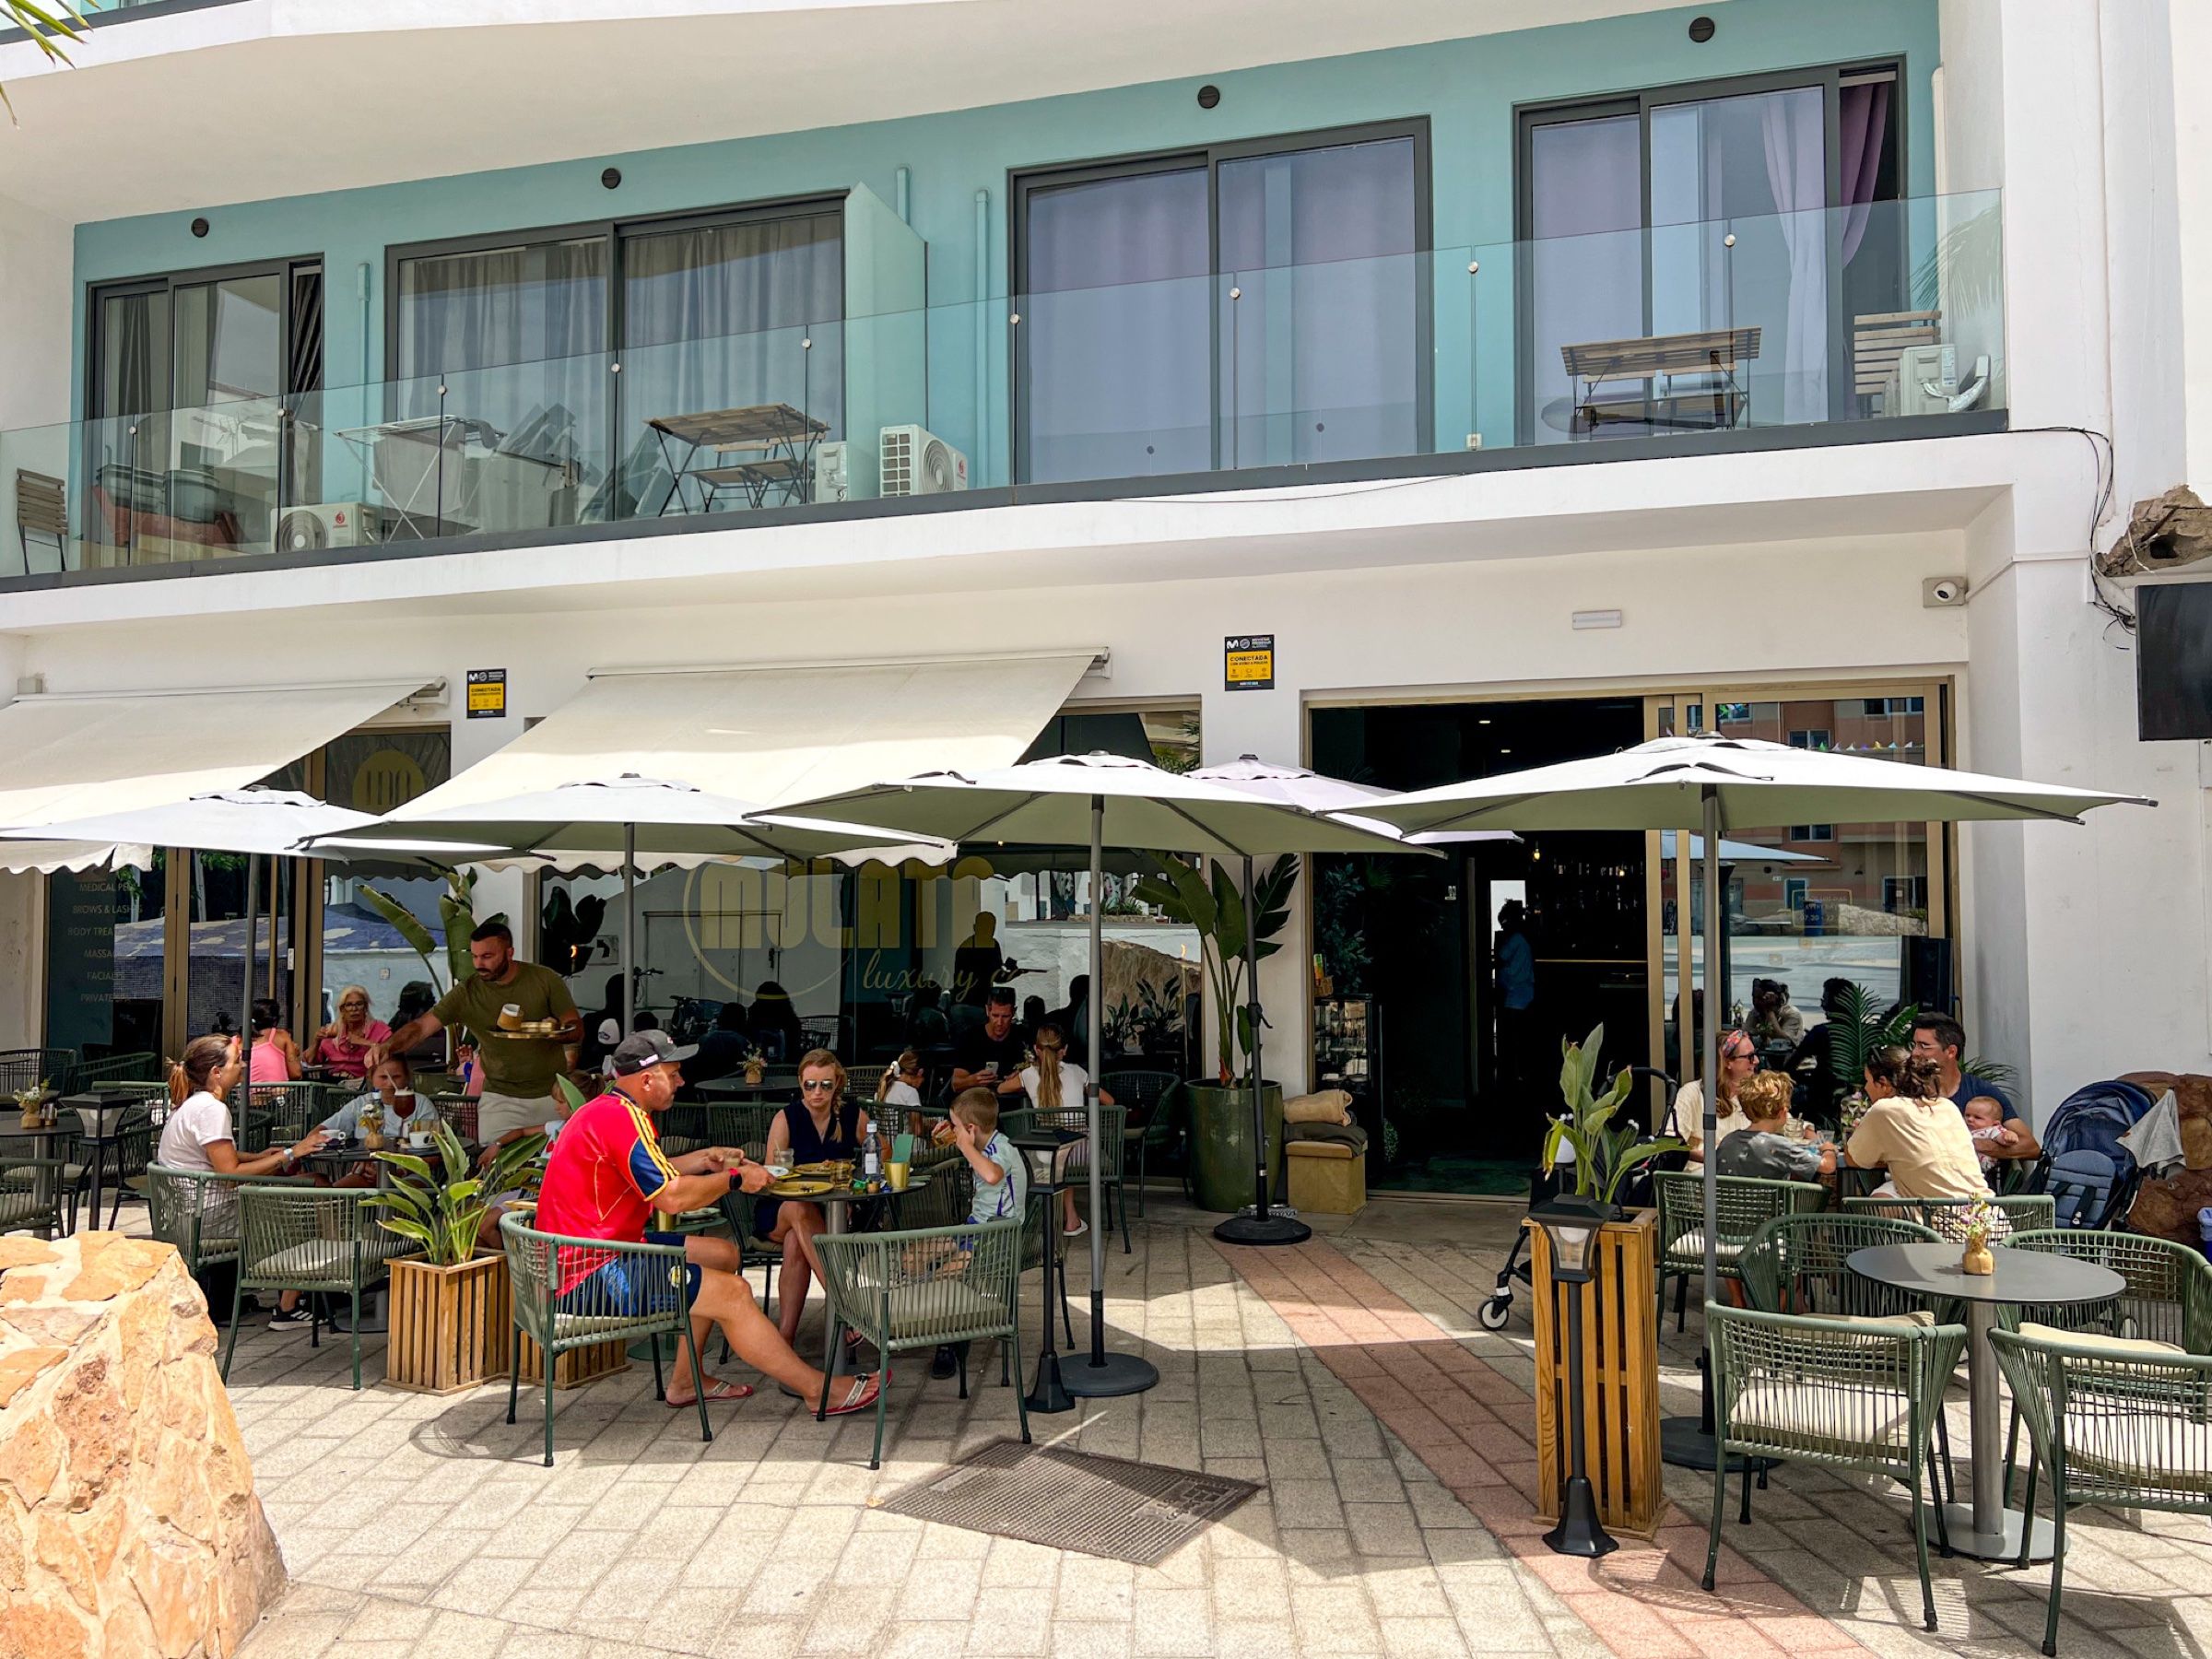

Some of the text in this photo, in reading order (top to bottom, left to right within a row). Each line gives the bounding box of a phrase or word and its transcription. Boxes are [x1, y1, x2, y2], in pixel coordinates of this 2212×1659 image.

[79, 883, 115, 893] MEDICAL
[73, 905, 103, 914] BROWS
[104, 905, 111, 914] &
[67, 927, 91, 936] BODY
[862, 948, 978, 1002] luxury
